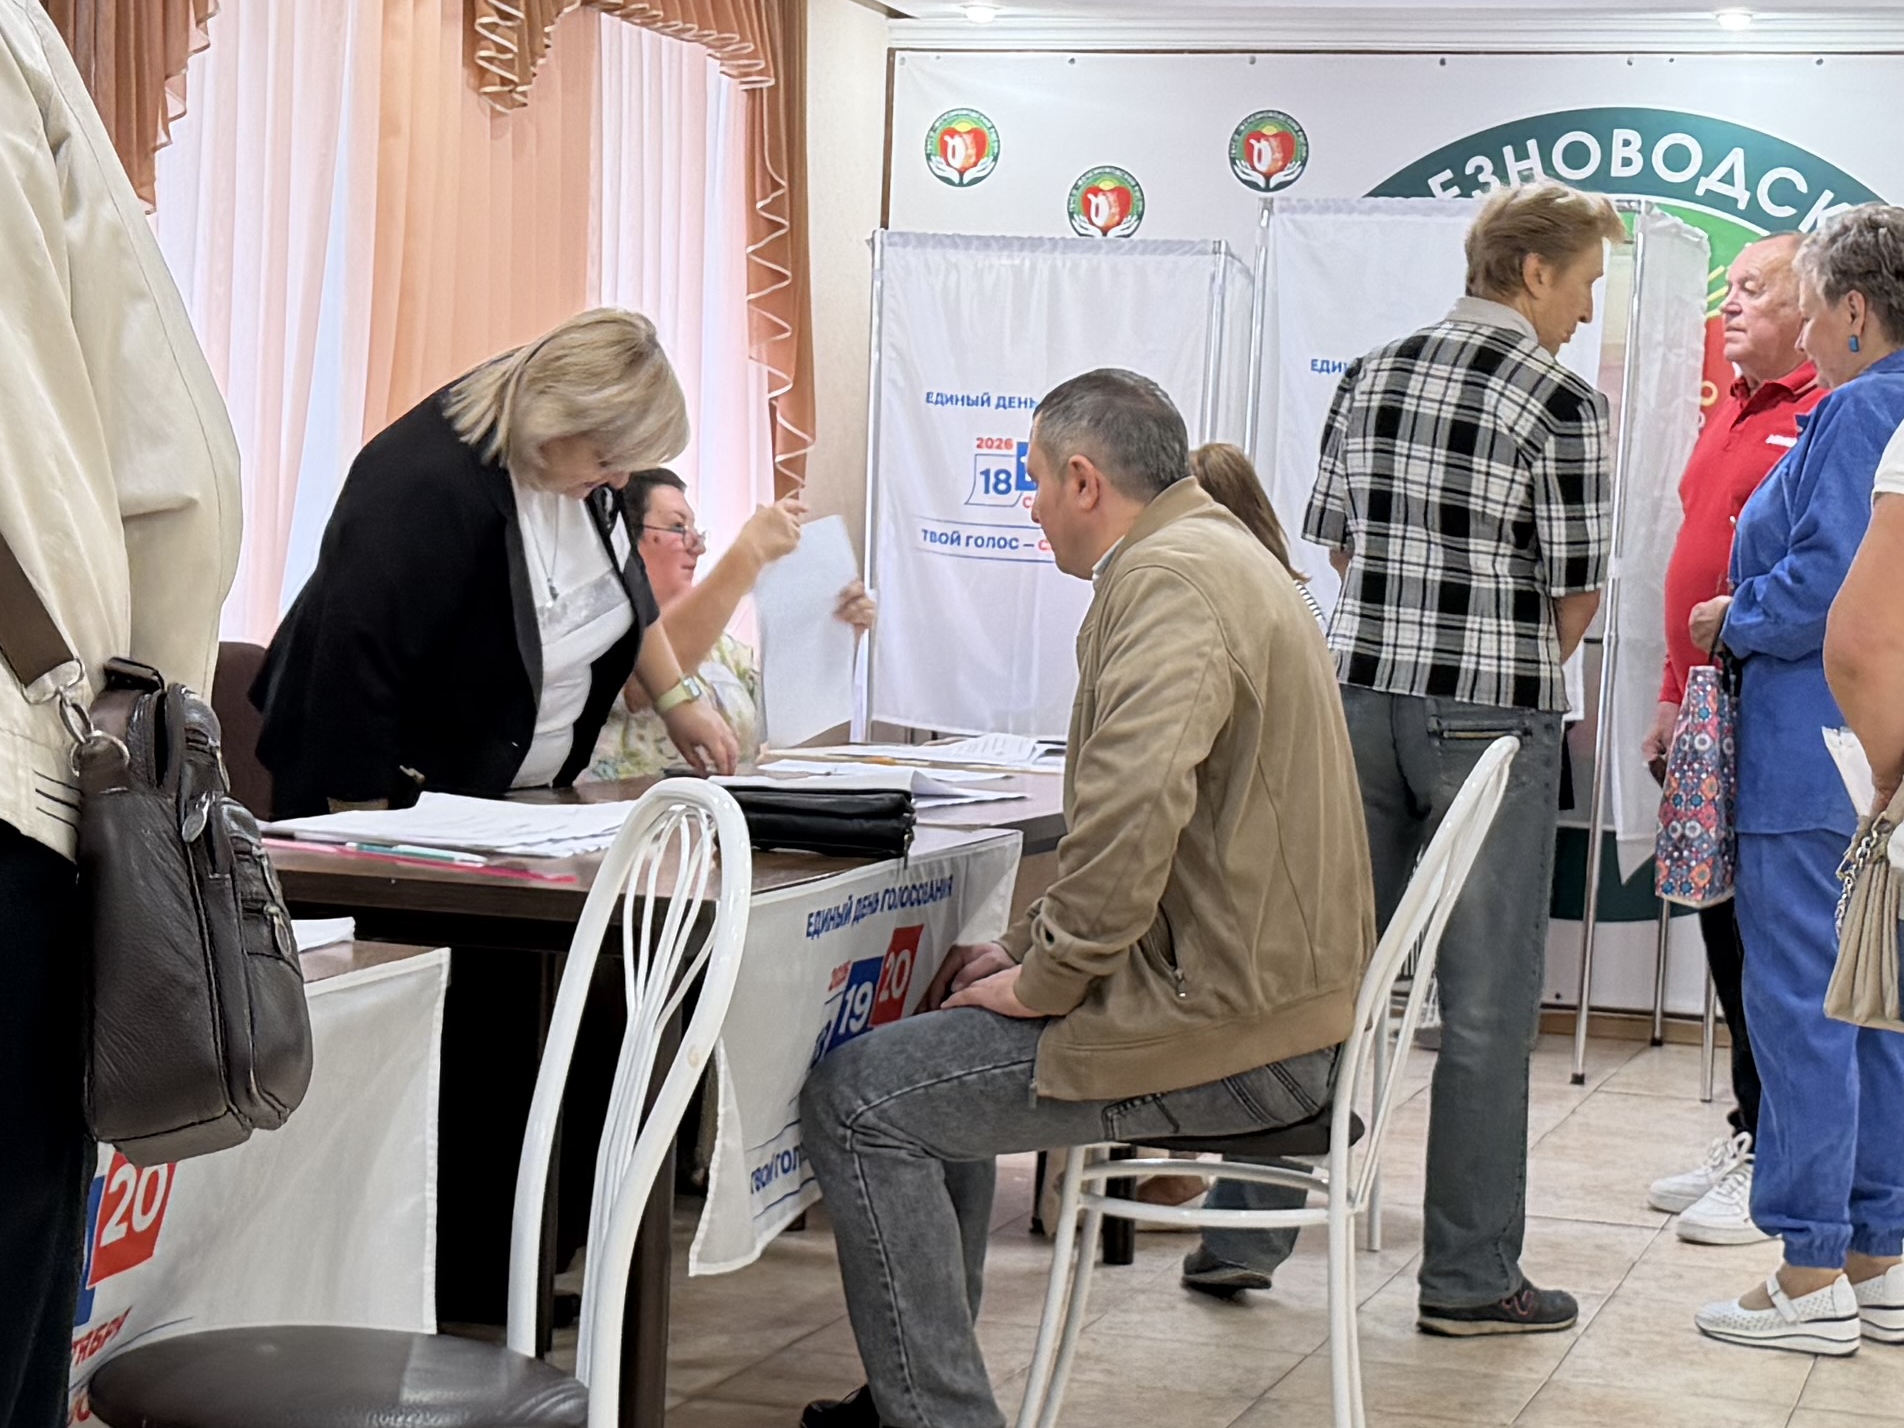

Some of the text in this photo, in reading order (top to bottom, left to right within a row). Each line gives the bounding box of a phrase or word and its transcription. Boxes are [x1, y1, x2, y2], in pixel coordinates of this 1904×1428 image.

[1310, 358, 1347, 374] ЕДИ
[925, 391, 991, 408] ЕДИНЫЙ
[975, 437, 1014, 450] 2026
[979, 468, 1013, 496] 18
[921, 528, 961, 547] ТВОЙ
[965, 534, 1019, 551] ГОЛОС
[806, 894, 853, 940] ЕДИНЫЙ
[879, 949, 912, 1003] 20
[838, 981, 874, 1036] 19
[100, 1163, 168, 1248] 20
